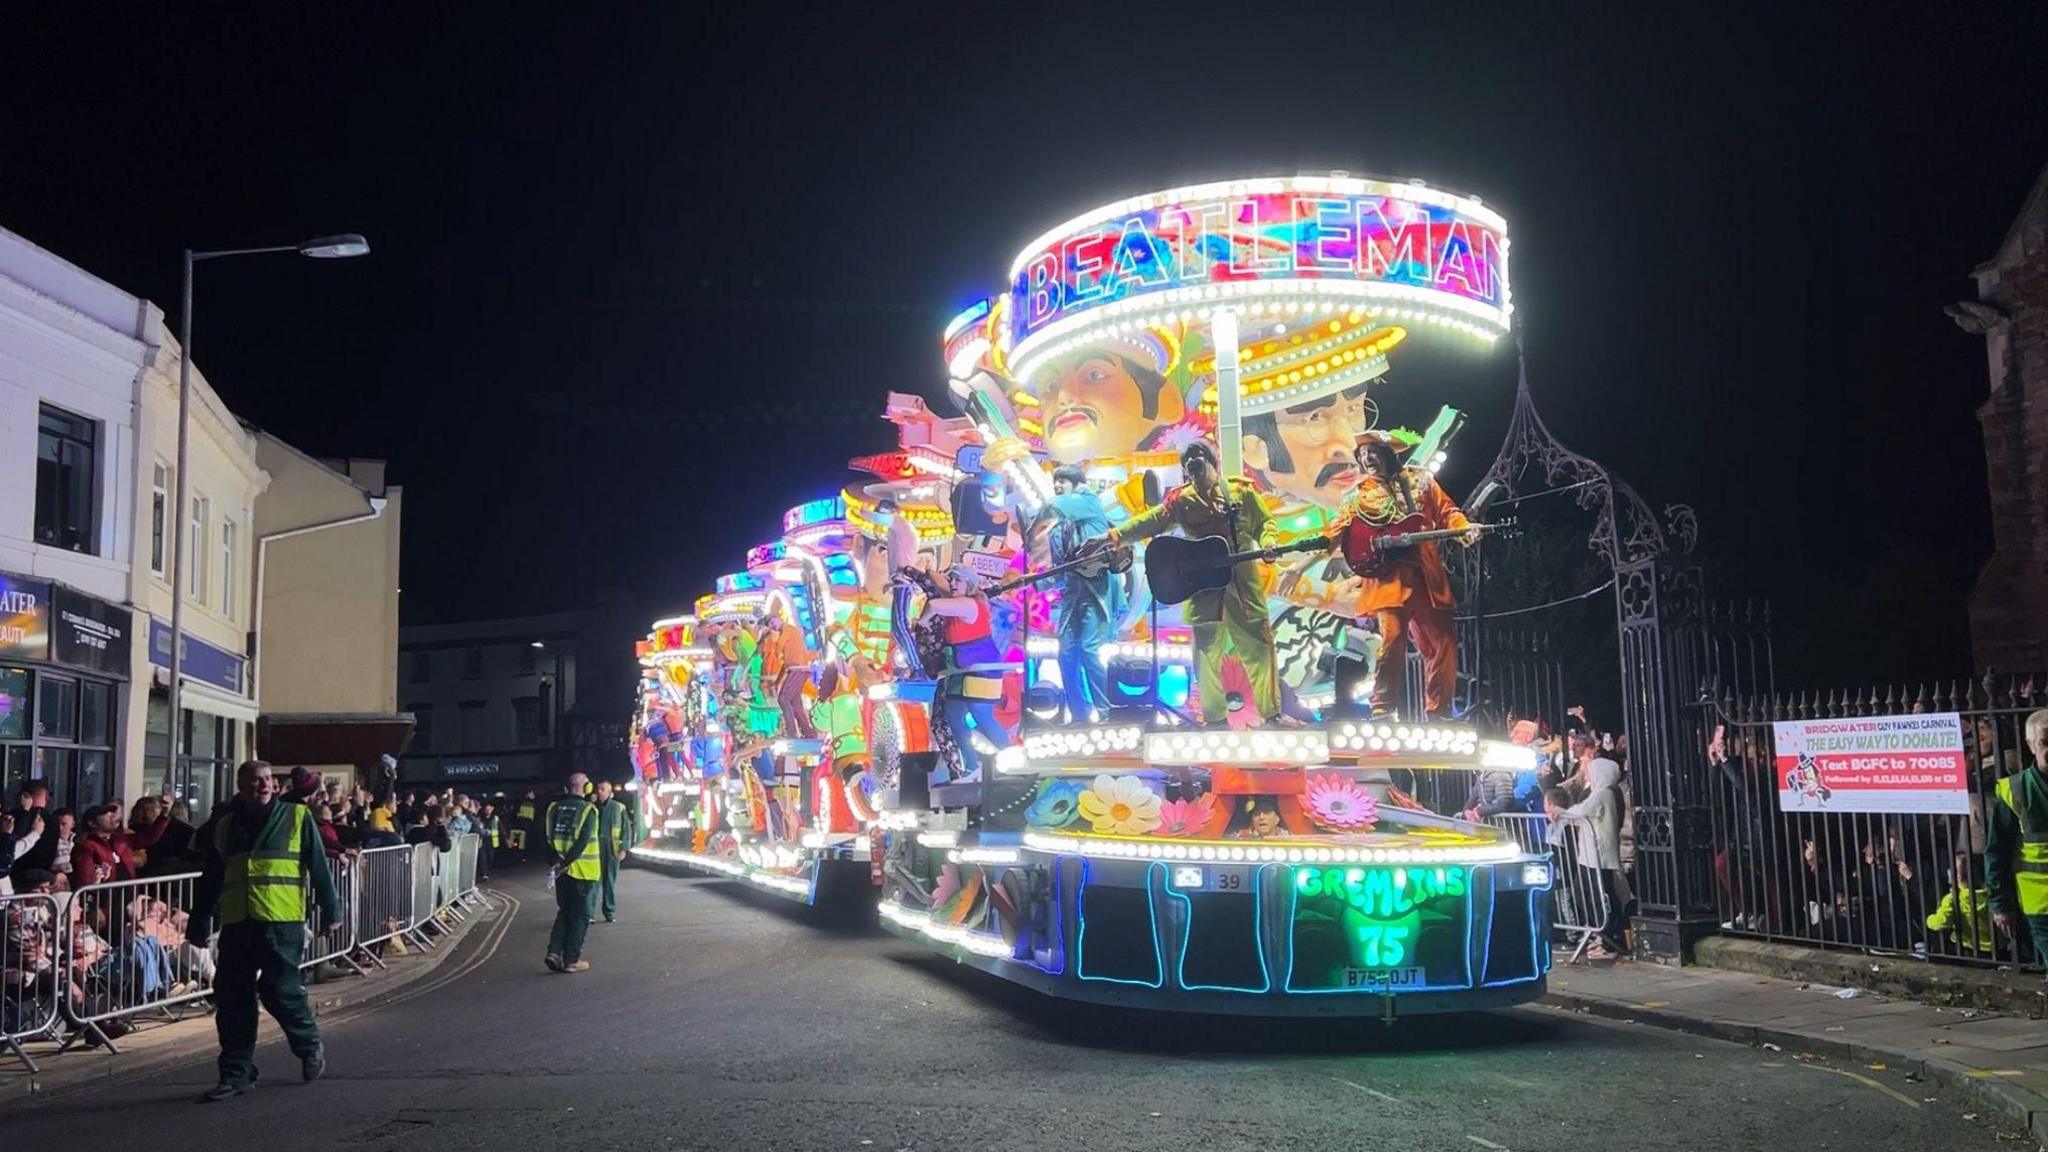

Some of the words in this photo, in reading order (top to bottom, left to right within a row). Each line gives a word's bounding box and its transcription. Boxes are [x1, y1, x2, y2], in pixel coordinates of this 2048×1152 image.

[971, 556, 1001, 572] ABBEY
[0, 589, 36, 616] ATER
[0, 624, 26, 644] AUTY
[1804, 722, 1877, 735] BRIDGWATER
[1877, 722, 1891, 732] GUY
[1921, 718, 1957, 730] CARNIVAL
[1806, 738, 1826, 751] THE
[1828, 736, 1854, 750] EASY
[1856, 734, 1883, 749] WAY
[1884, 734, 1899, 748] TO
[1902, 731, 1958, 748] DONATE!
[1820, 759, 1848, 771] Text
[1851, 758, 1888, 771] BGFC
[1890, 758, 1906, 770] to
[1908, 757, 1956, 770] 70085
[1824, 774, 1859, 783] Followed
[1860, 775, 1871, 784] by
[1934, 775, 1942, 783] or
[1219, 874, 1240, 889] 39
[1297, 867, 1465, 917] GREMLINS
[1358, 926, 1409, 966] 75
